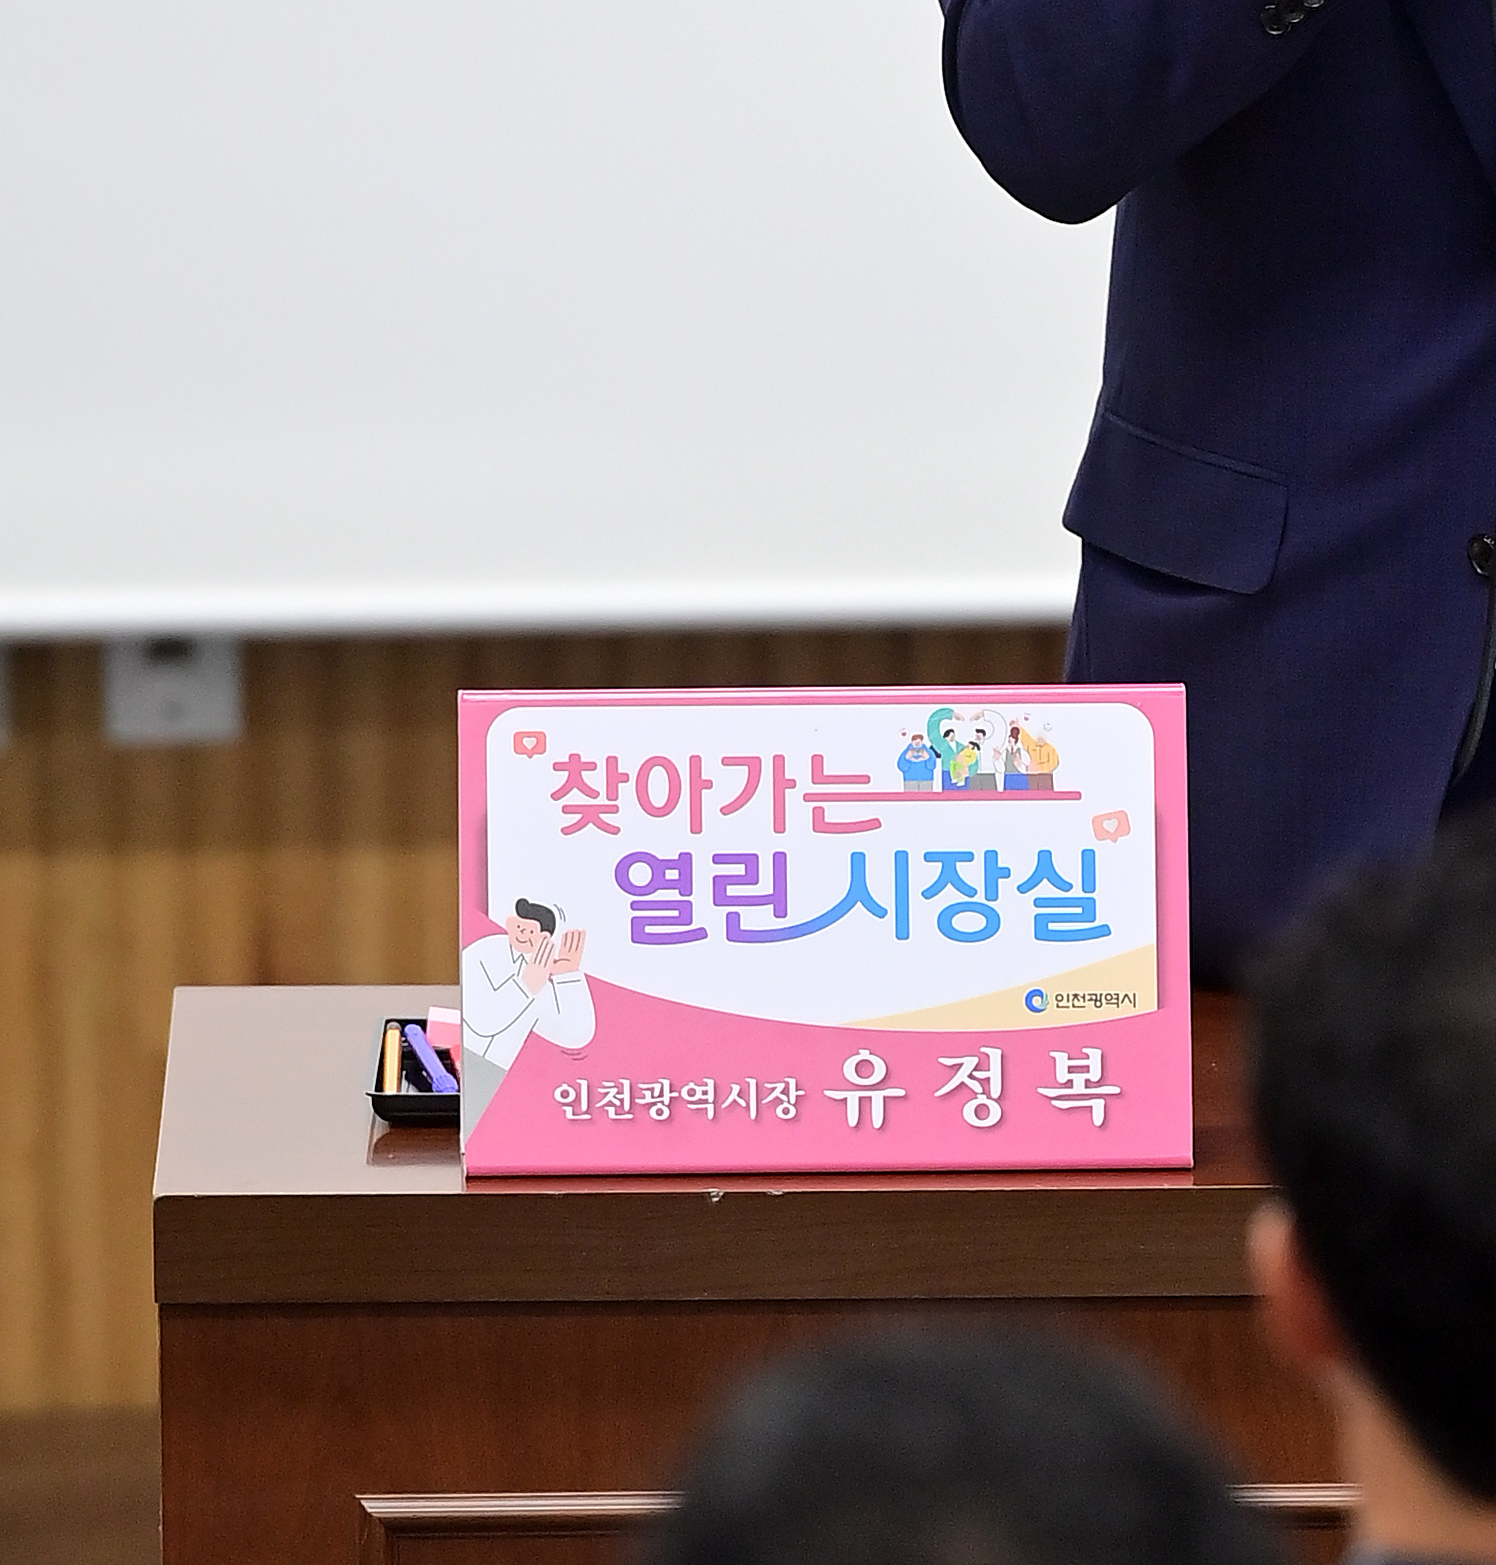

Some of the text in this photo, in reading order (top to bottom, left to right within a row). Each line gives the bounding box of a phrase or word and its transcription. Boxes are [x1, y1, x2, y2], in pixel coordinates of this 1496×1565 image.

[550, 751, 1082, 836] 찾아가는
[613, 848, 1112, 946] 열린 시장실
[1054, 991, 1137, 1009] 인천광역시
[552, 1076, 806, 1122] 인천광역시장
